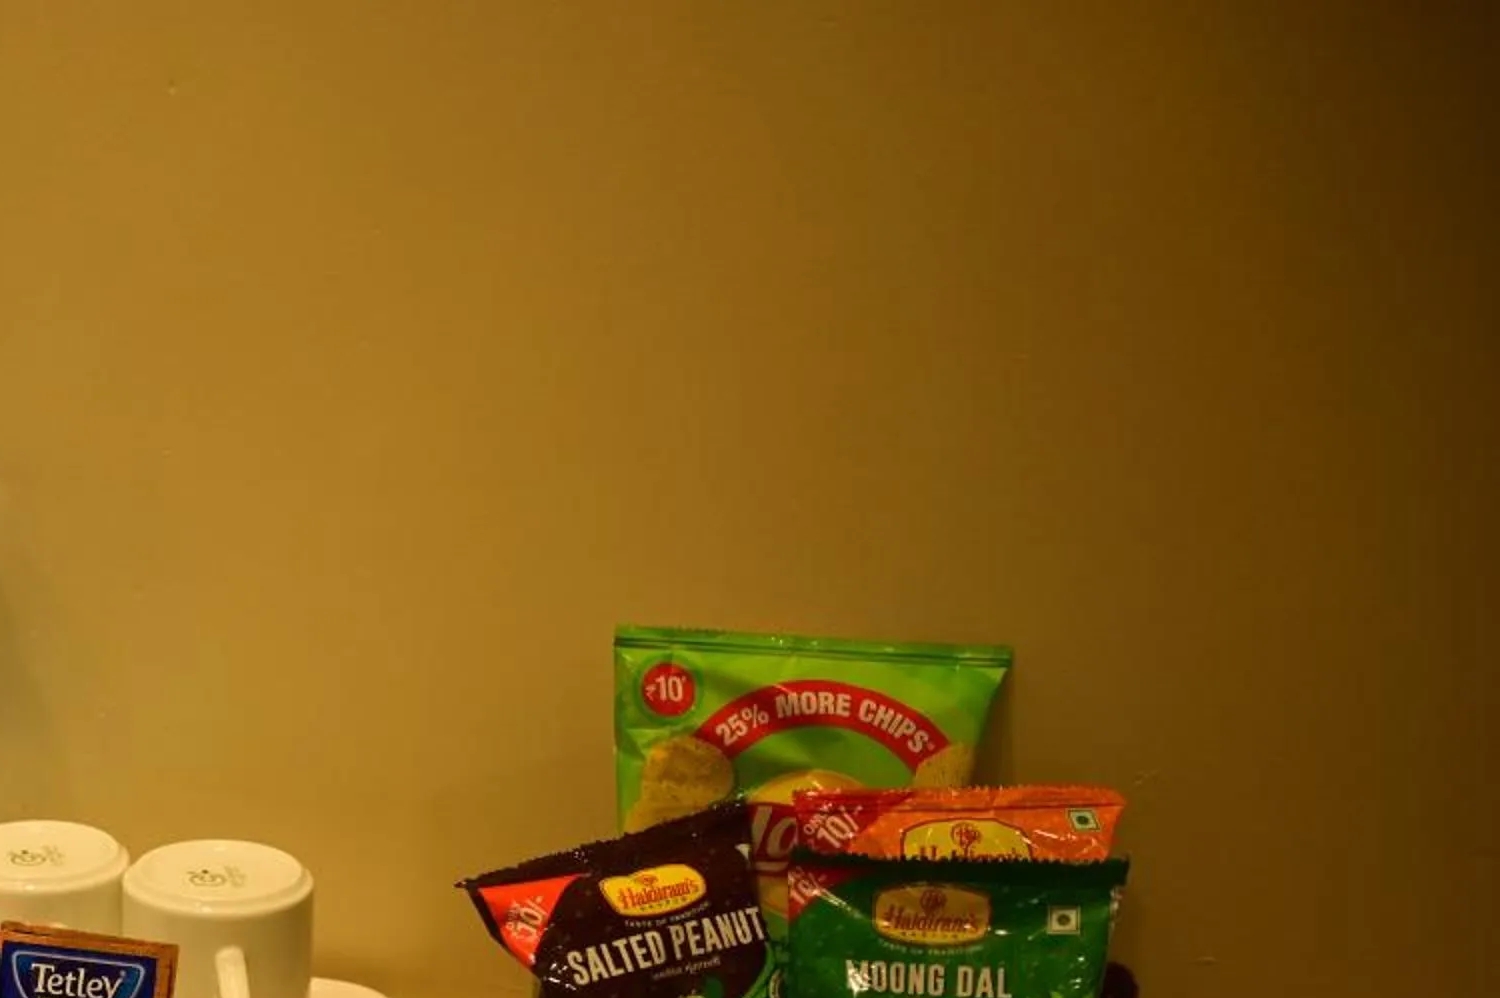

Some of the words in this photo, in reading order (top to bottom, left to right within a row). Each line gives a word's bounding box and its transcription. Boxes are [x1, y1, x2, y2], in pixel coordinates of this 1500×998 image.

[715, 704, 769, 747] 25%
[775, 691, 852, 719] MORE
[858, 699, 931, 754] CHIPS
[566, 930, 667, 986] SALTED
[668, 906, 766, 961] PEANUT
